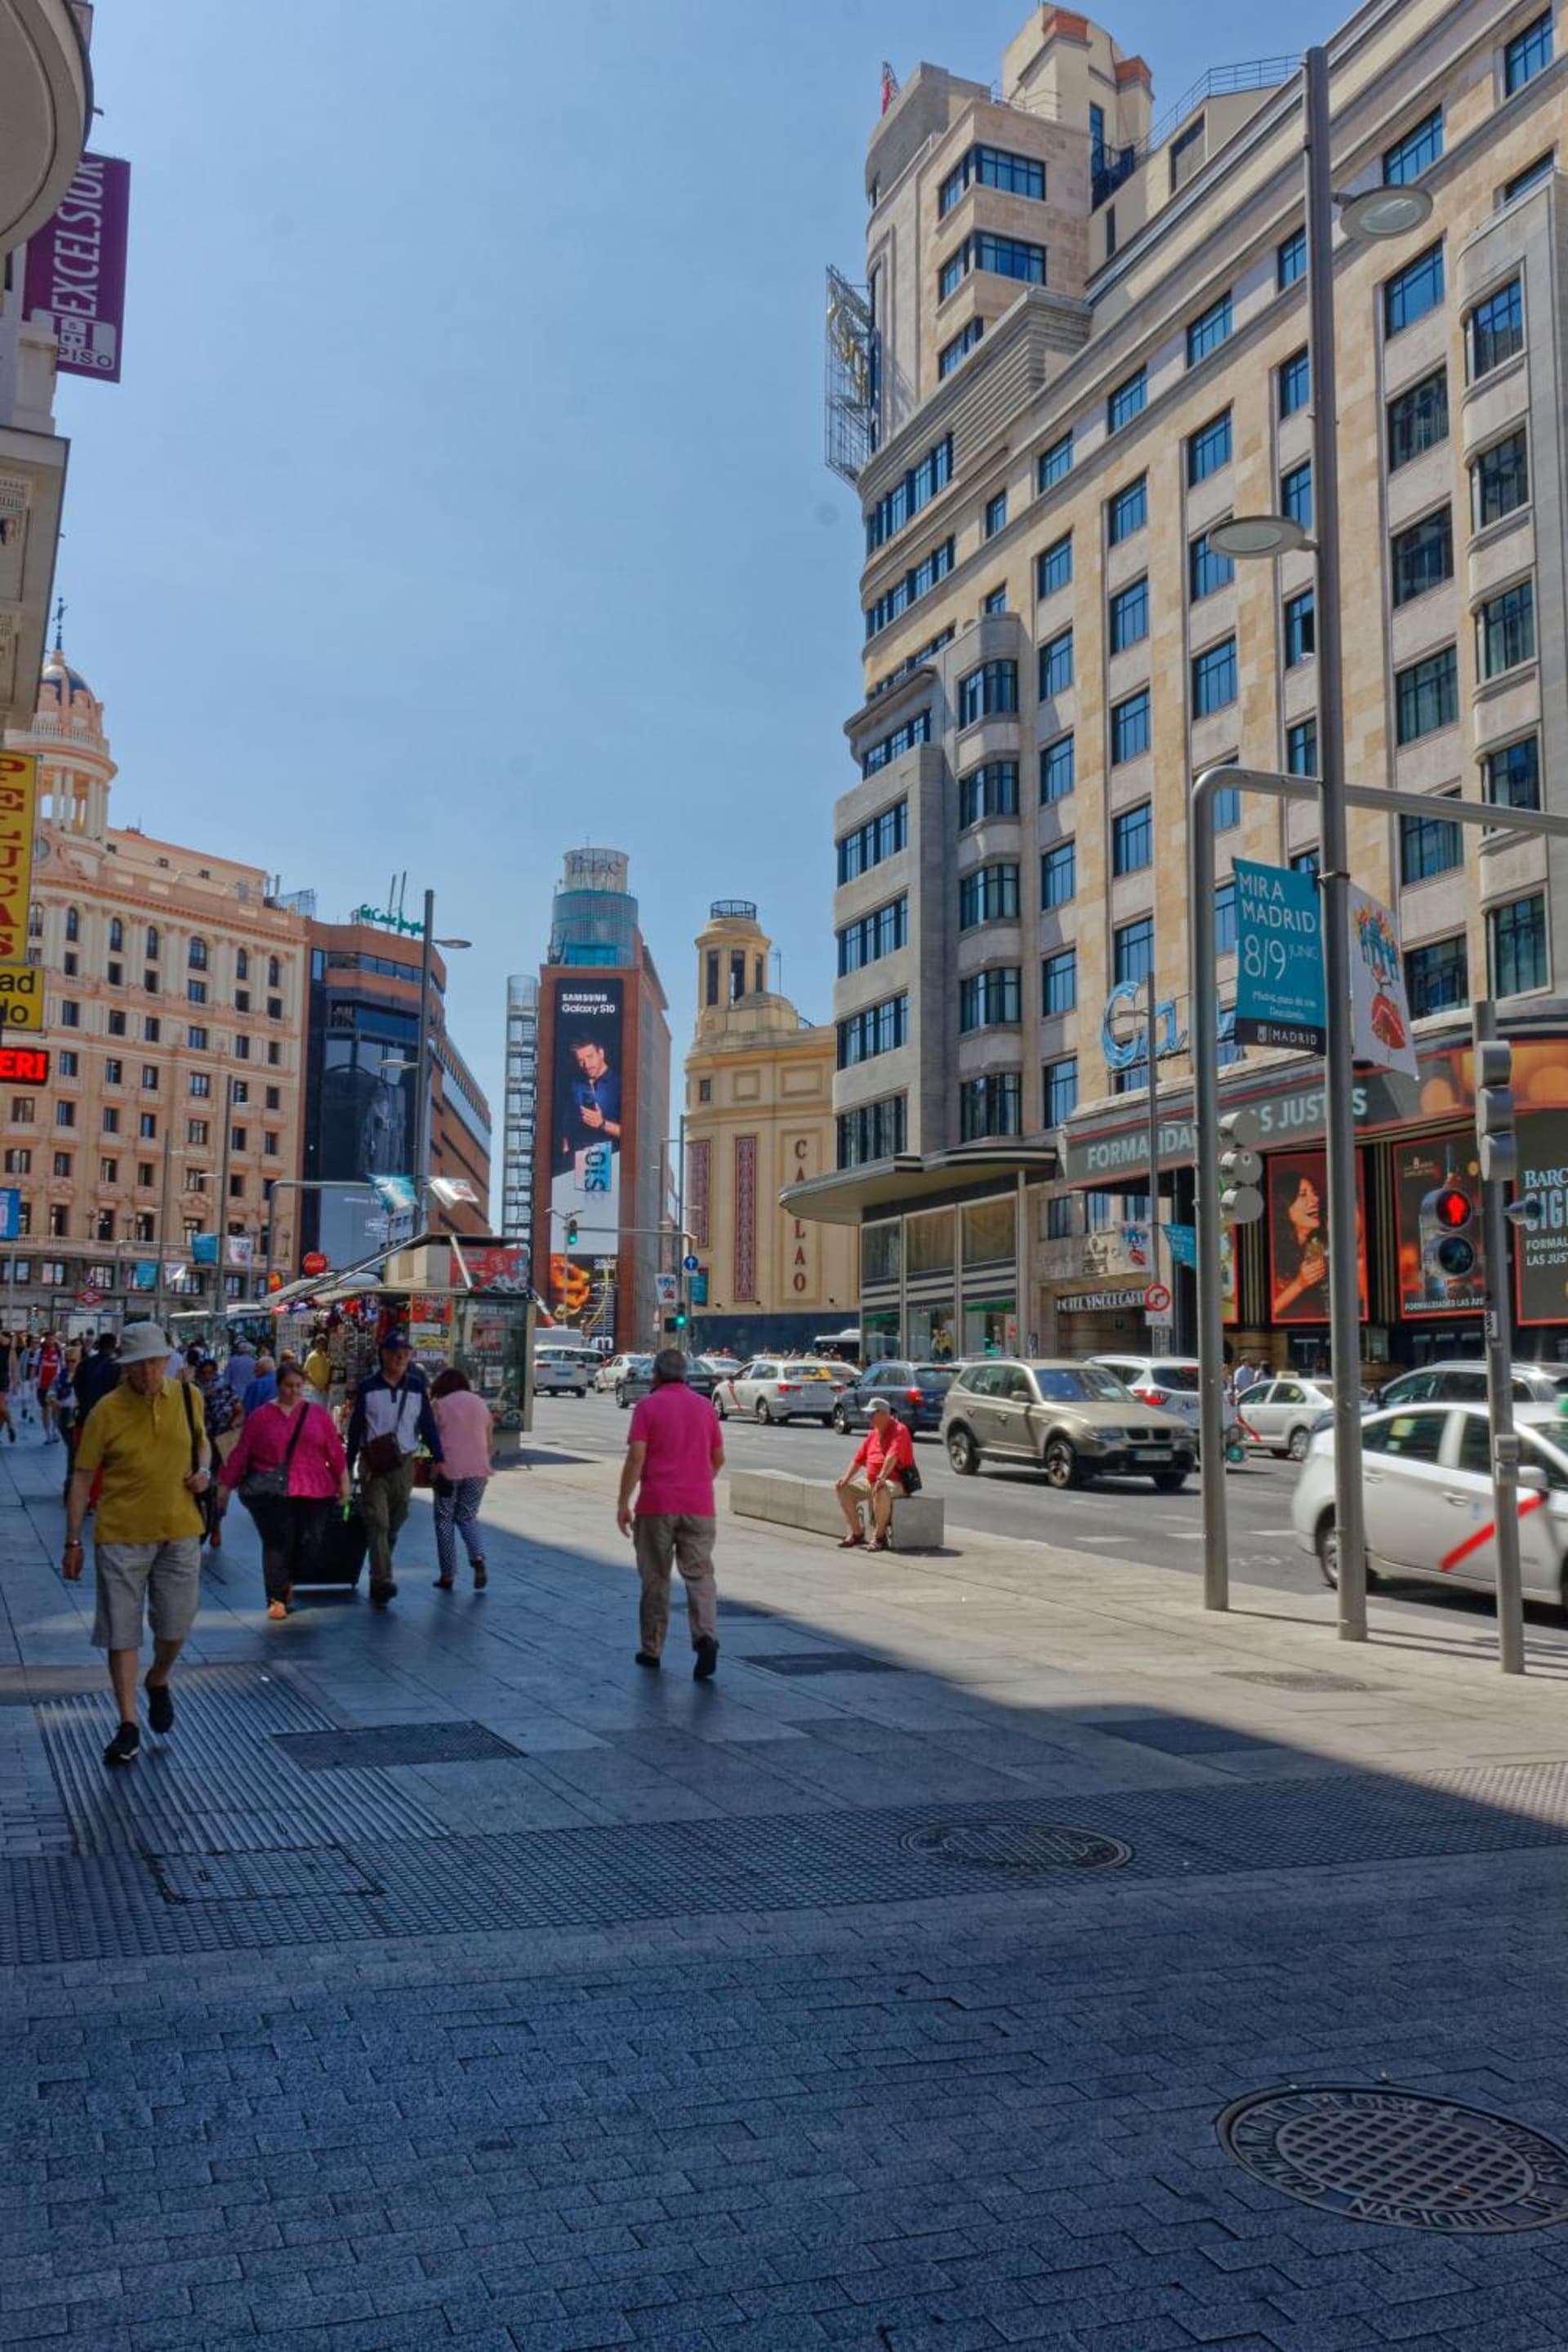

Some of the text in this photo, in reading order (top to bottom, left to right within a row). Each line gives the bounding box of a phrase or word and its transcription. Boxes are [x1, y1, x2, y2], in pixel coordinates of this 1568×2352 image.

[1239, 871, 1285, 903] MIRA
[1241, 898, 1316, 933] MADRID
[1244, 933, 1287, 980] 8/9
[562, 1004, 616, 1015] Galaxy S10
[1272, 1029, 1317, 1045] MADRID
[792, 1138, 808, 1293] CALAO
